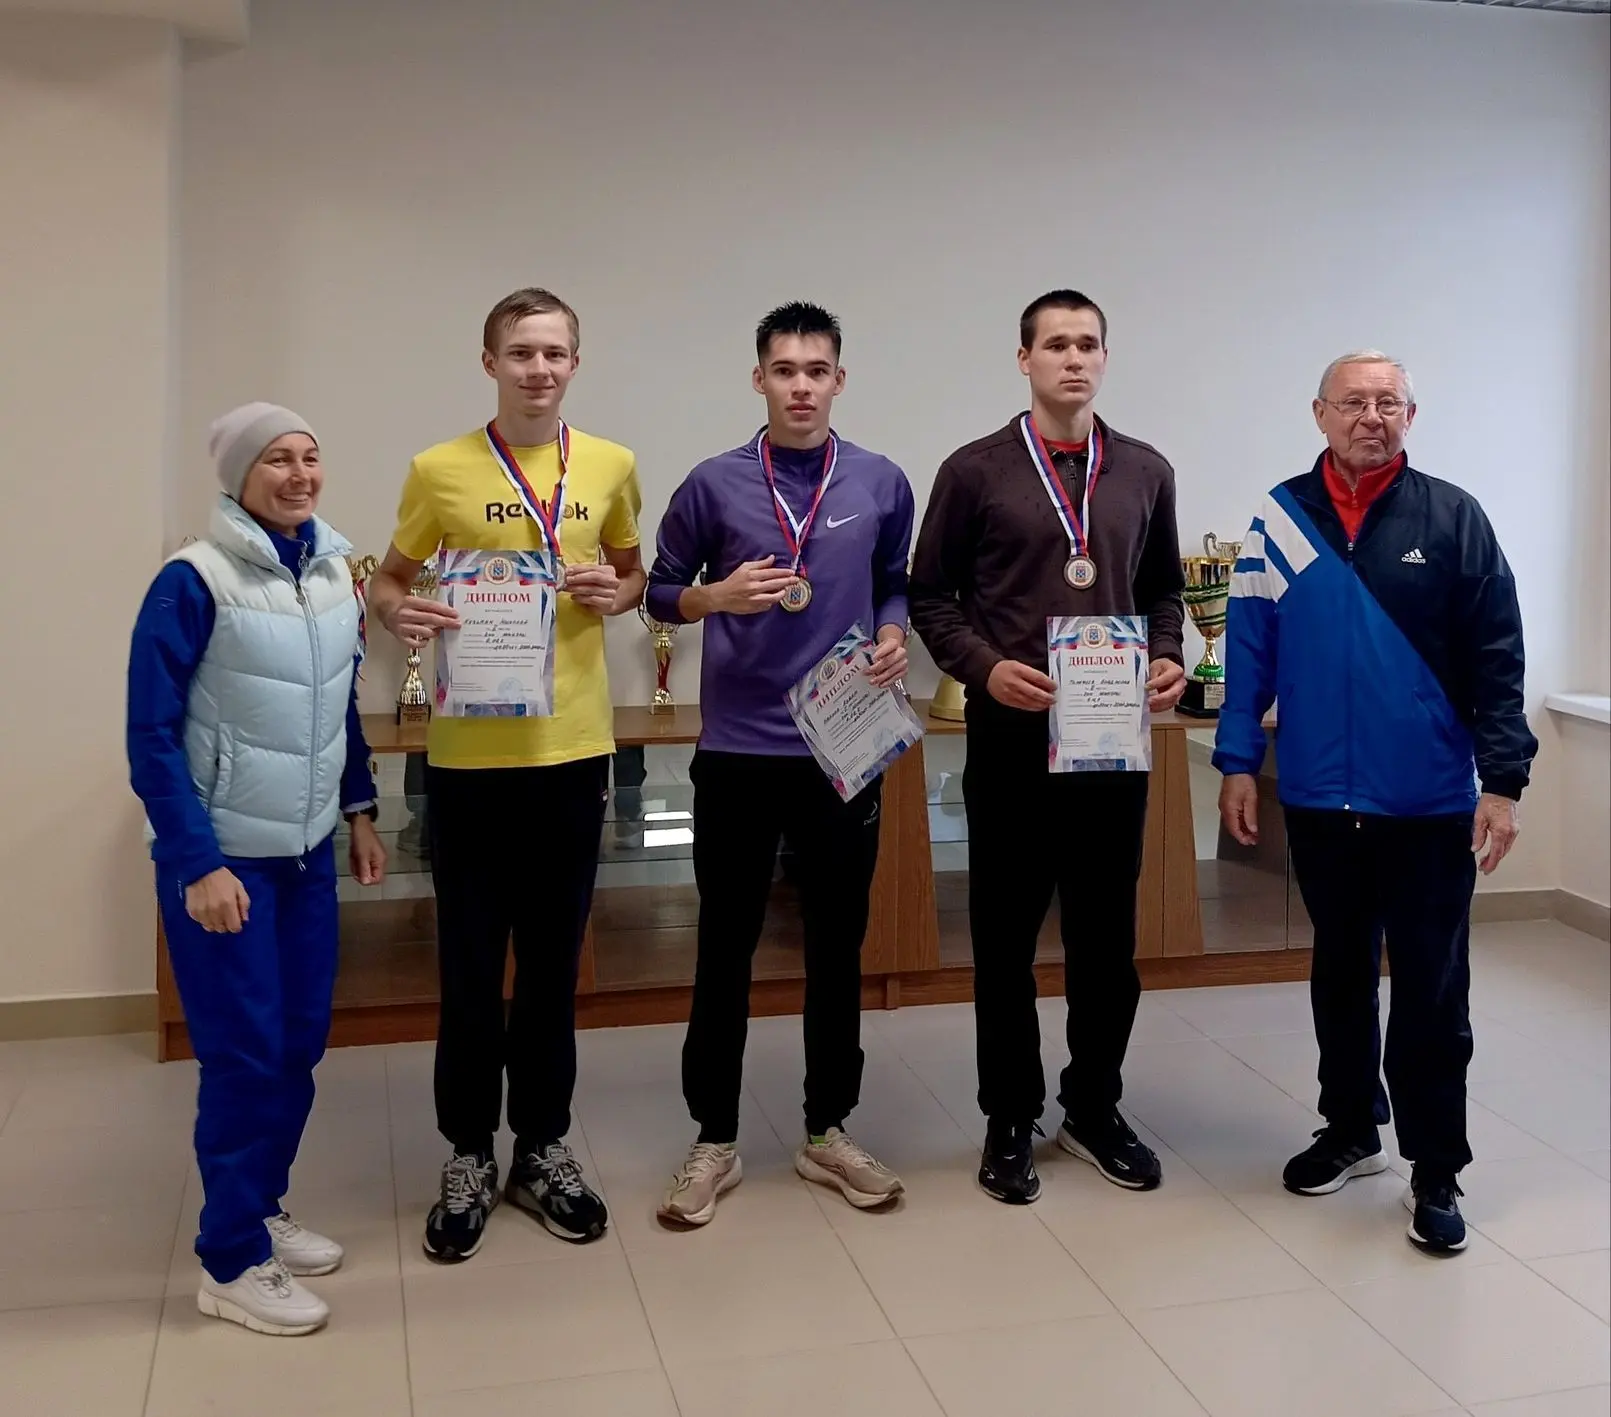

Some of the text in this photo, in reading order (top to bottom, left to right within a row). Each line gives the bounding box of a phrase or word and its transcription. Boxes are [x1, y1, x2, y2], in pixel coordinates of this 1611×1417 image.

[1401, 556, 1426, 564] adidas
[464, 592, 530, 604] ДИПЛОМ
[1068, 655, 1125, 667] ДИПЛОМ
[815, 664, 861, 713] ДИПЛОМ
